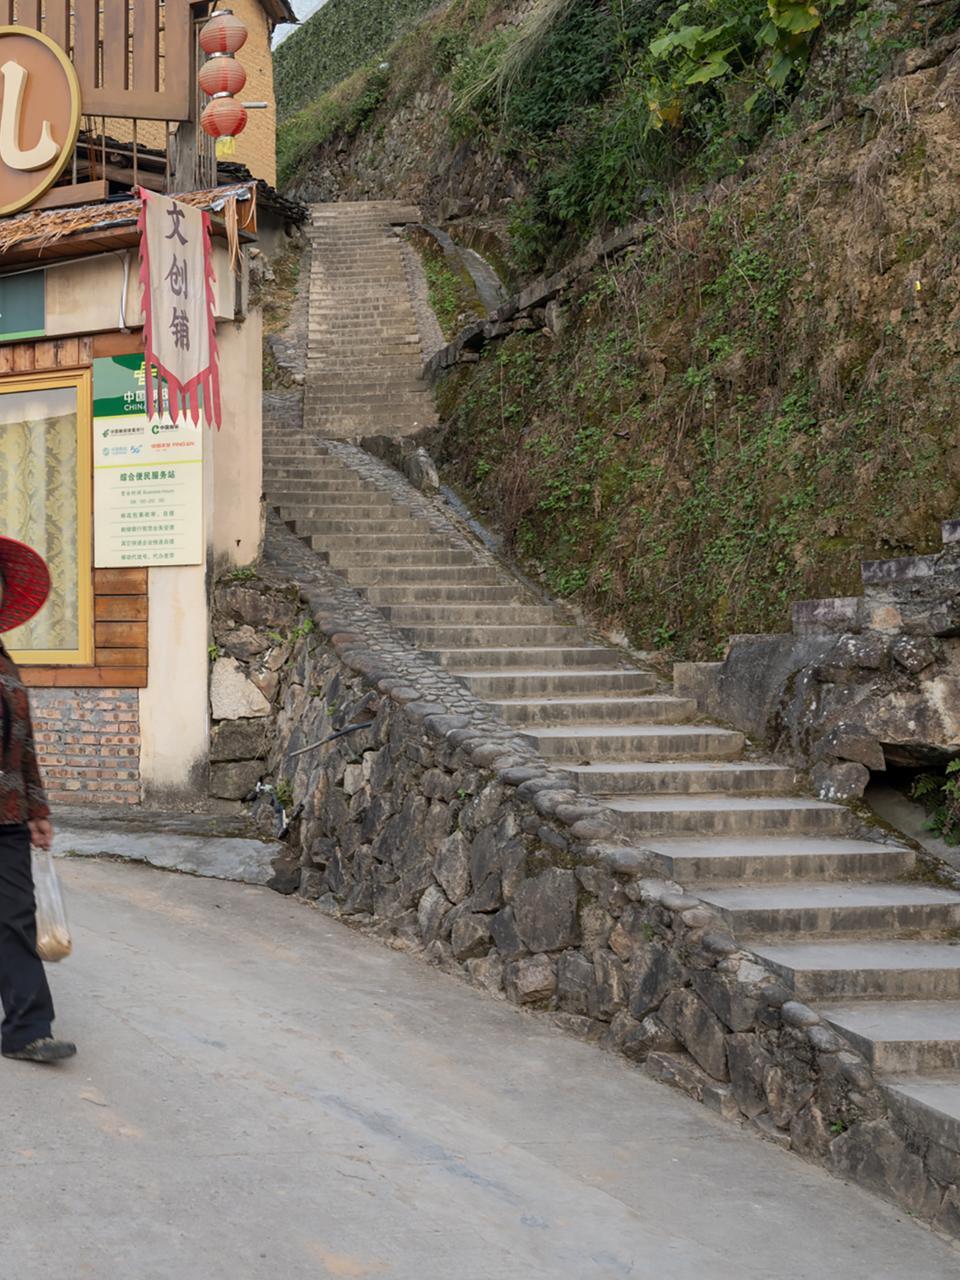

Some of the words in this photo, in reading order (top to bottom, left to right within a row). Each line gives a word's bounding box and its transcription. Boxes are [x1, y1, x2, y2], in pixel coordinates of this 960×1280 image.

[164, 201, 191, 352] 文创铺
[119, 470, 176, 482] 综合便民服务站
